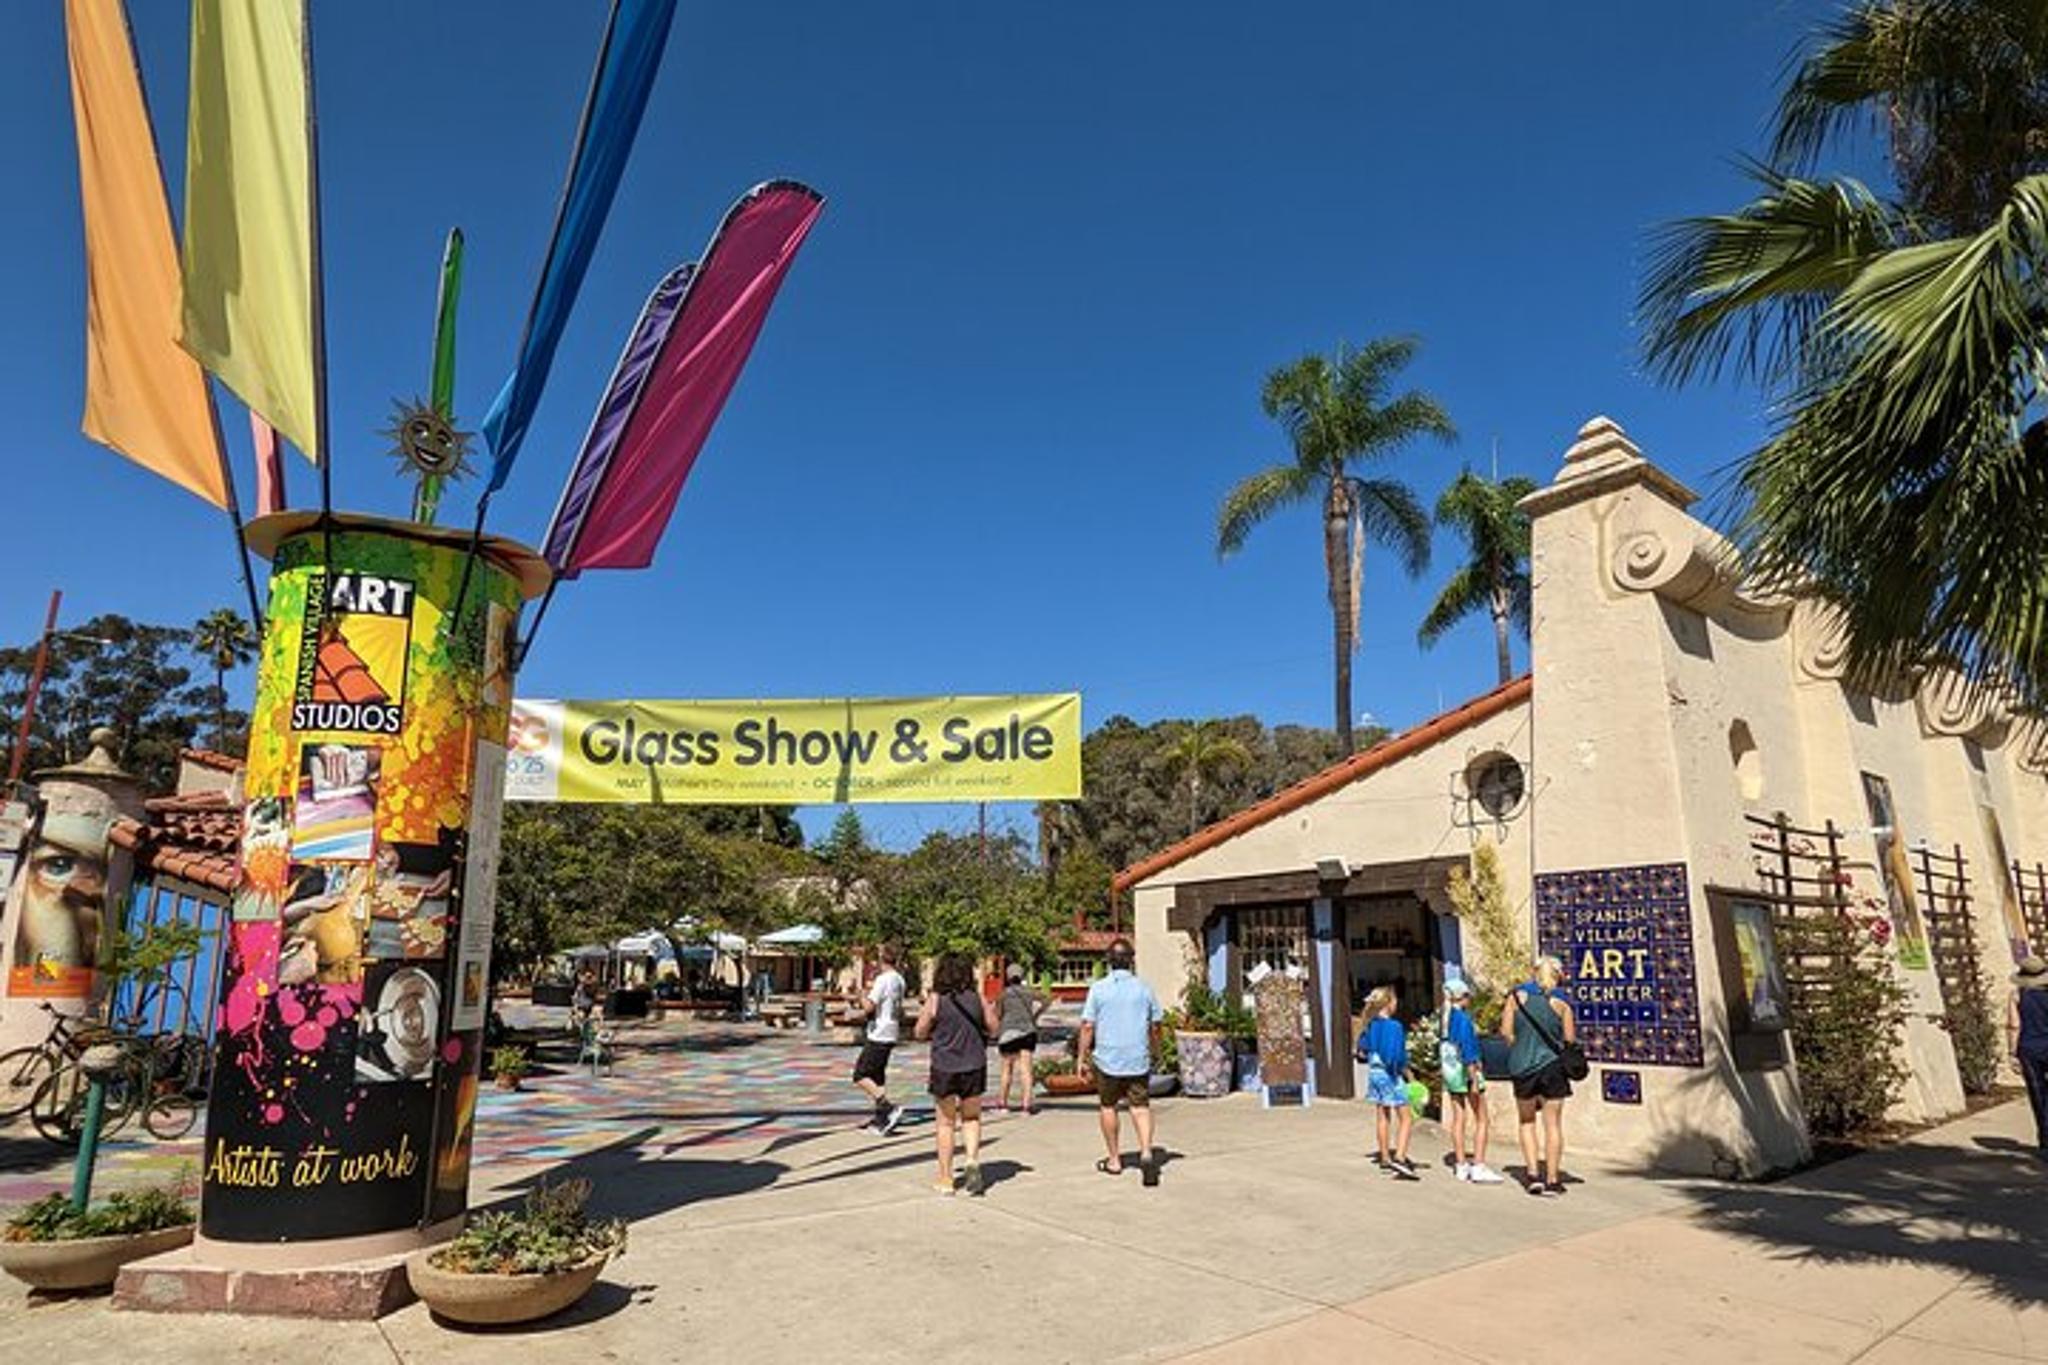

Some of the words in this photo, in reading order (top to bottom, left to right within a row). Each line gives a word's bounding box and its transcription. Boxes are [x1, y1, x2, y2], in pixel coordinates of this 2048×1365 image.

[305, 576, 327, 637] VILLAGE
[331, 576, 413, 615] ART
[297, 639, 318, 702] SPANISH
[293, 704, 400, 732] STUDIOS
[581, 717, 720, 766] Glass
[733, 716, 878, 766] Show
[890, 717, 928, 764] &
[941, 714, 1054, 763] Sale
[1575, 907, 1646, 925] SPANISH
[1575, 926, 1648, 943] VILLAGE
[1578, 948, 1648, 980] ART
[1577, 986, 1653, 1002] CENTER
[205, 1137, 284, 1188] Artists
[292, 1145, 340, 1187] at
[340, 1133, 419, 1186] work
